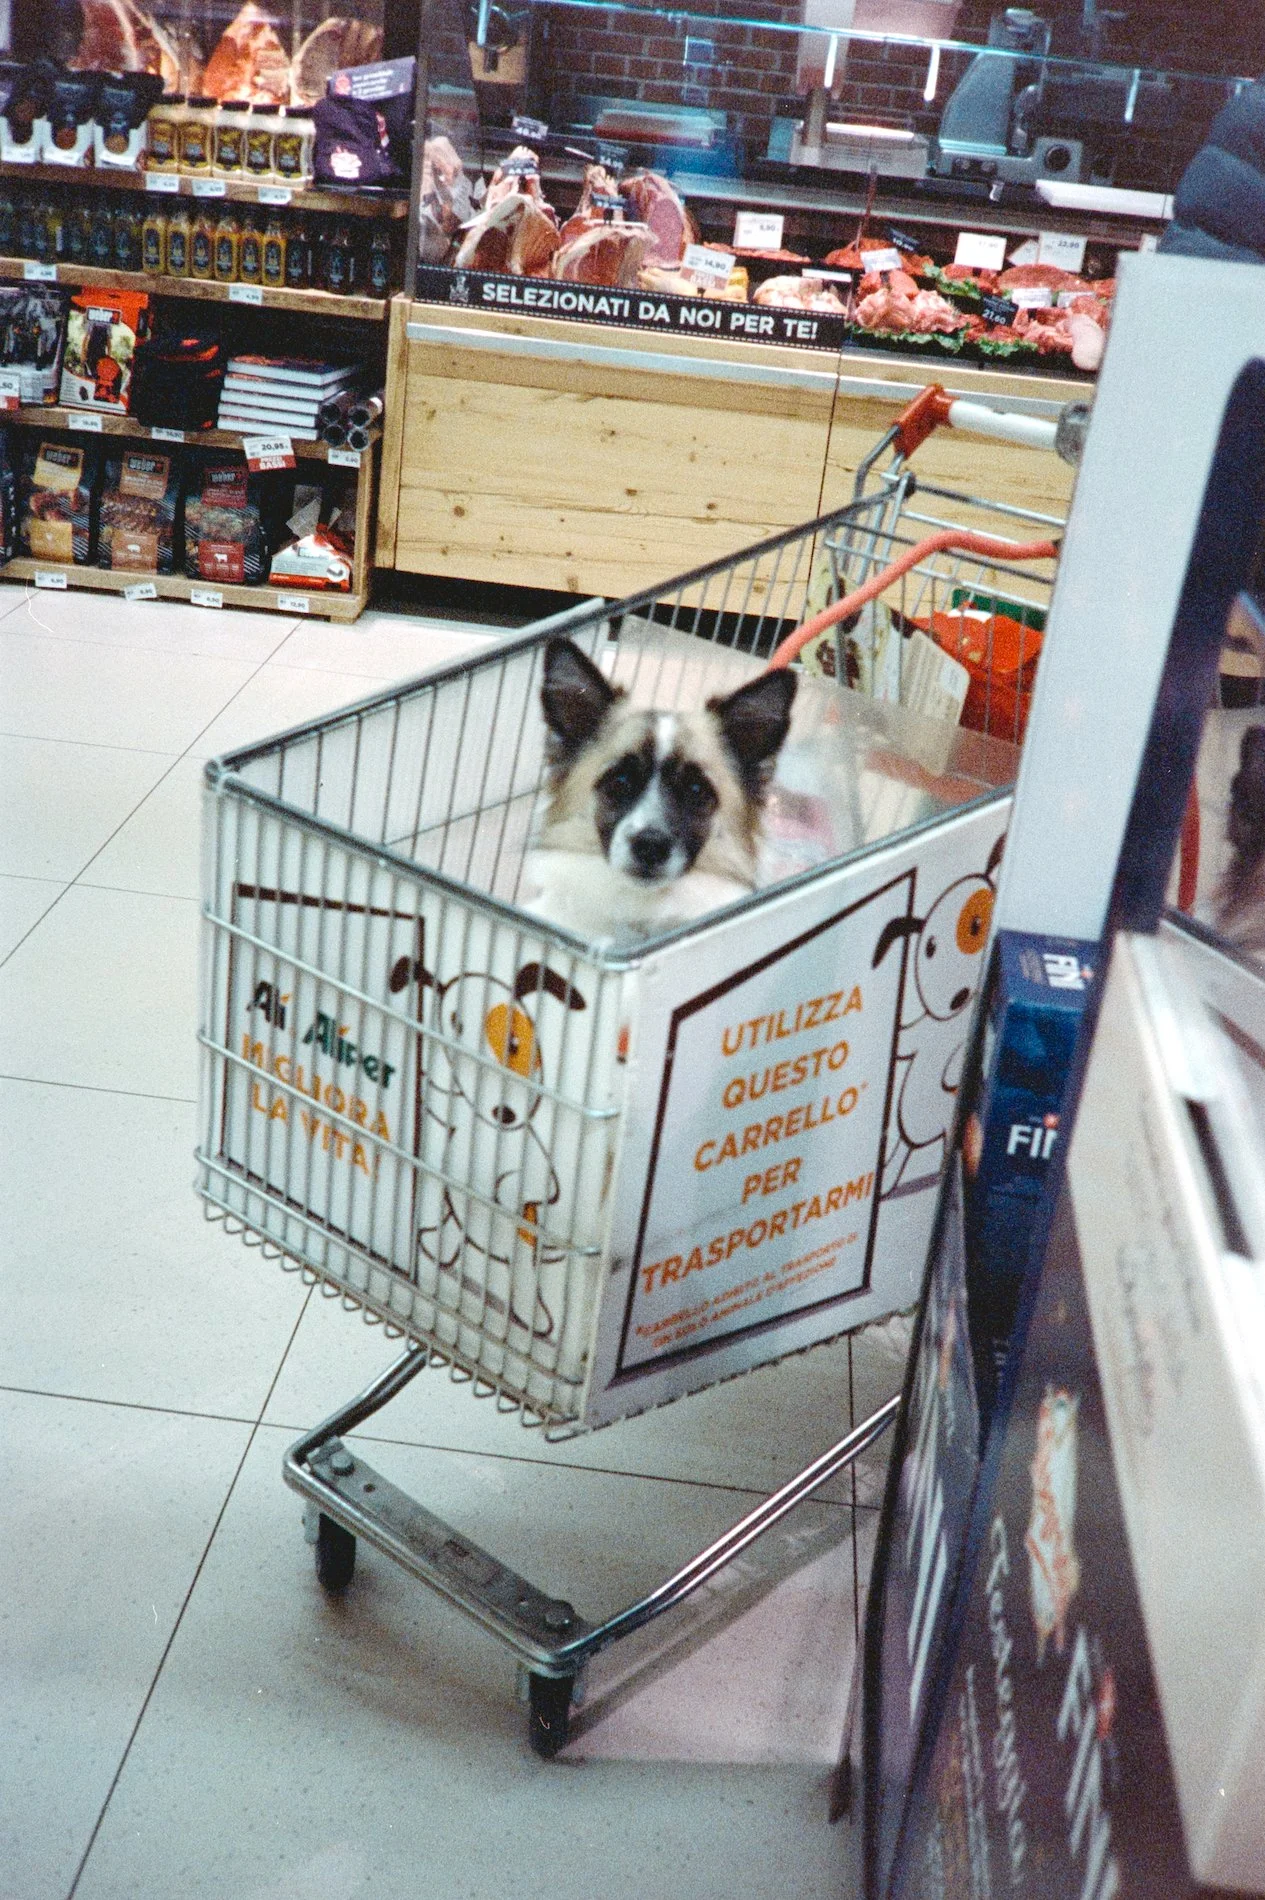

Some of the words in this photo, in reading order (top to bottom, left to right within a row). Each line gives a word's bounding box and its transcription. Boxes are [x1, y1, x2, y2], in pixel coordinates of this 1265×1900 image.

[704, 259, 726, 270] 14,90
[482, 283, 630, 318] SELEZIONATI
[638, 300, 671, 324] DA
[679, 307, 721, 329] NOI
[730, 314, 774, 336] PER
[783, 319, 818, 340] TE!
[982, 309, 1006, 326] 21,60
[129, 456, 156, 472] weber
[261, 442, 285, 451] 20,95
[211, 471, 237, 483] weber
[720, 983, 864, 1058] UTILIZZA
[721, 1039, 851, 1110] QUESTO
[252, 1082, 288, 1123] LA
[740, 1156, 804, 1206] PER
[639, 1171, 874, 1296] TRASPORTARMI
